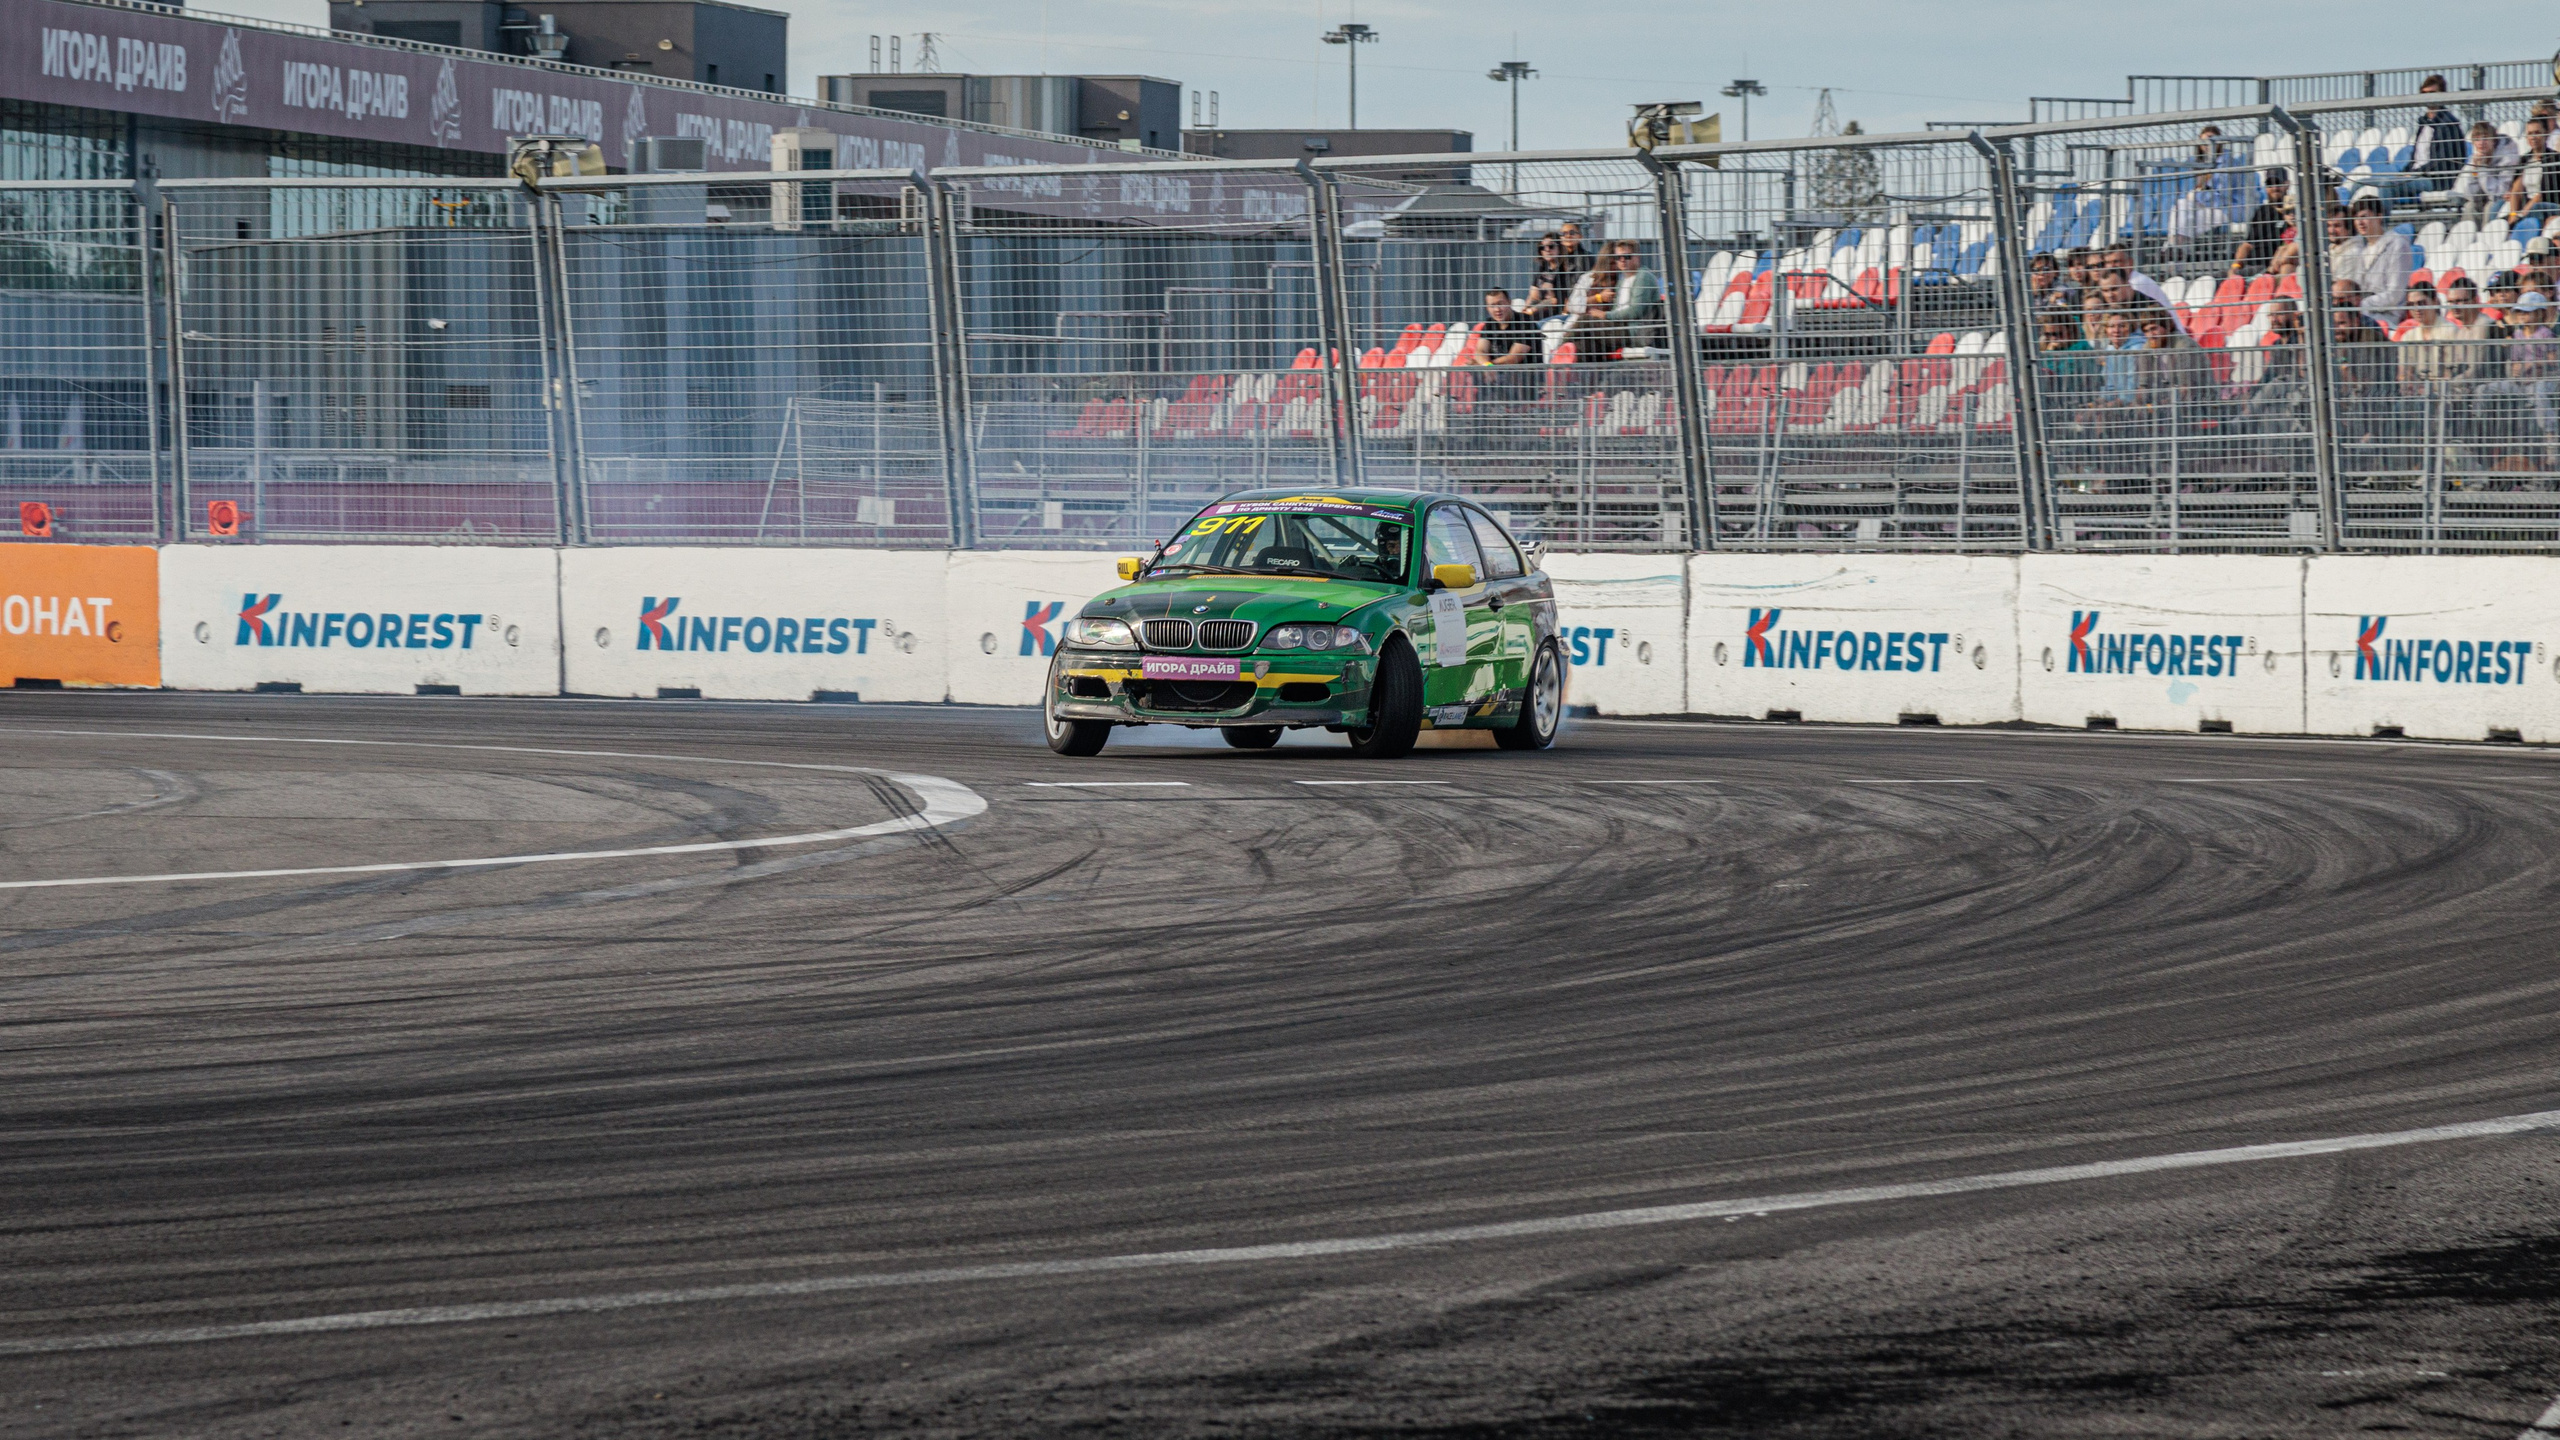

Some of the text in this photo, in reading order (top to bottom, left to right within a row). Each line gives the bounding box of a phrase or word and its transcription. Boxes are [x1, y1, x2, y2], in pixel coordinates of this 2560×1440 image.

[42, 27, 112, 83] ИГОРА
[283, 60, 344, 112] ИГОРА
[492, 87, 546, 133] ИГОРА
[1191, 516, 1268, 536] 911
[1271, 502, 1363, 511] САНКТ-ПЕТЕРБУРГА
[1266, 557, 1300, 567] RECARO
[235, 592, 484, 649] KINFOREST
[636, 596, 877, 655] KINFOREST
[1743, 608, 1950, 672] KINFOREST
[2067, 610, 2244, 677] KINFOREST
[1146, 662, 1236, 676] ИГОРА ДРАЙВ
[2355, 615, 2533, 684] KINFOREST
